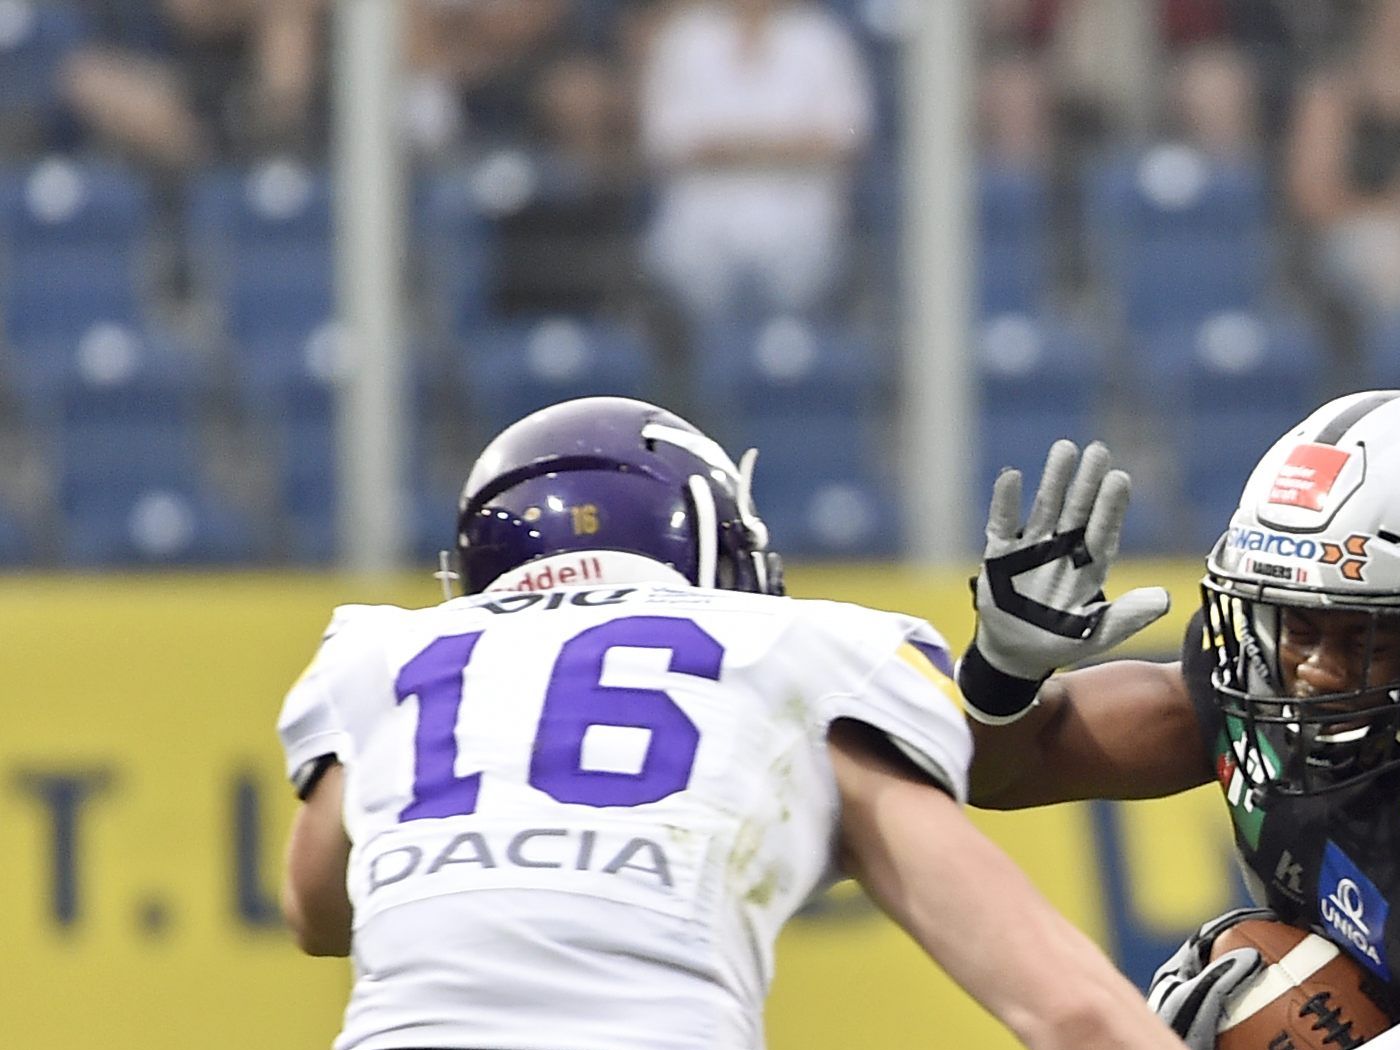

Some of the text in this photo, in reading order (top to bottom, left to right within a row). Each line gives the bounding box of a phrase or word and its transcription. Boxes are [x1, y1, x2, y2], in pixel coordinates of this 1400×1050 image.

[570, 505, 599, 535] 16
[394, 615, 724, 824] 16
[368, 828, 673, 889] DACIA
[1321, 898, 1383, 965] UNIQA
